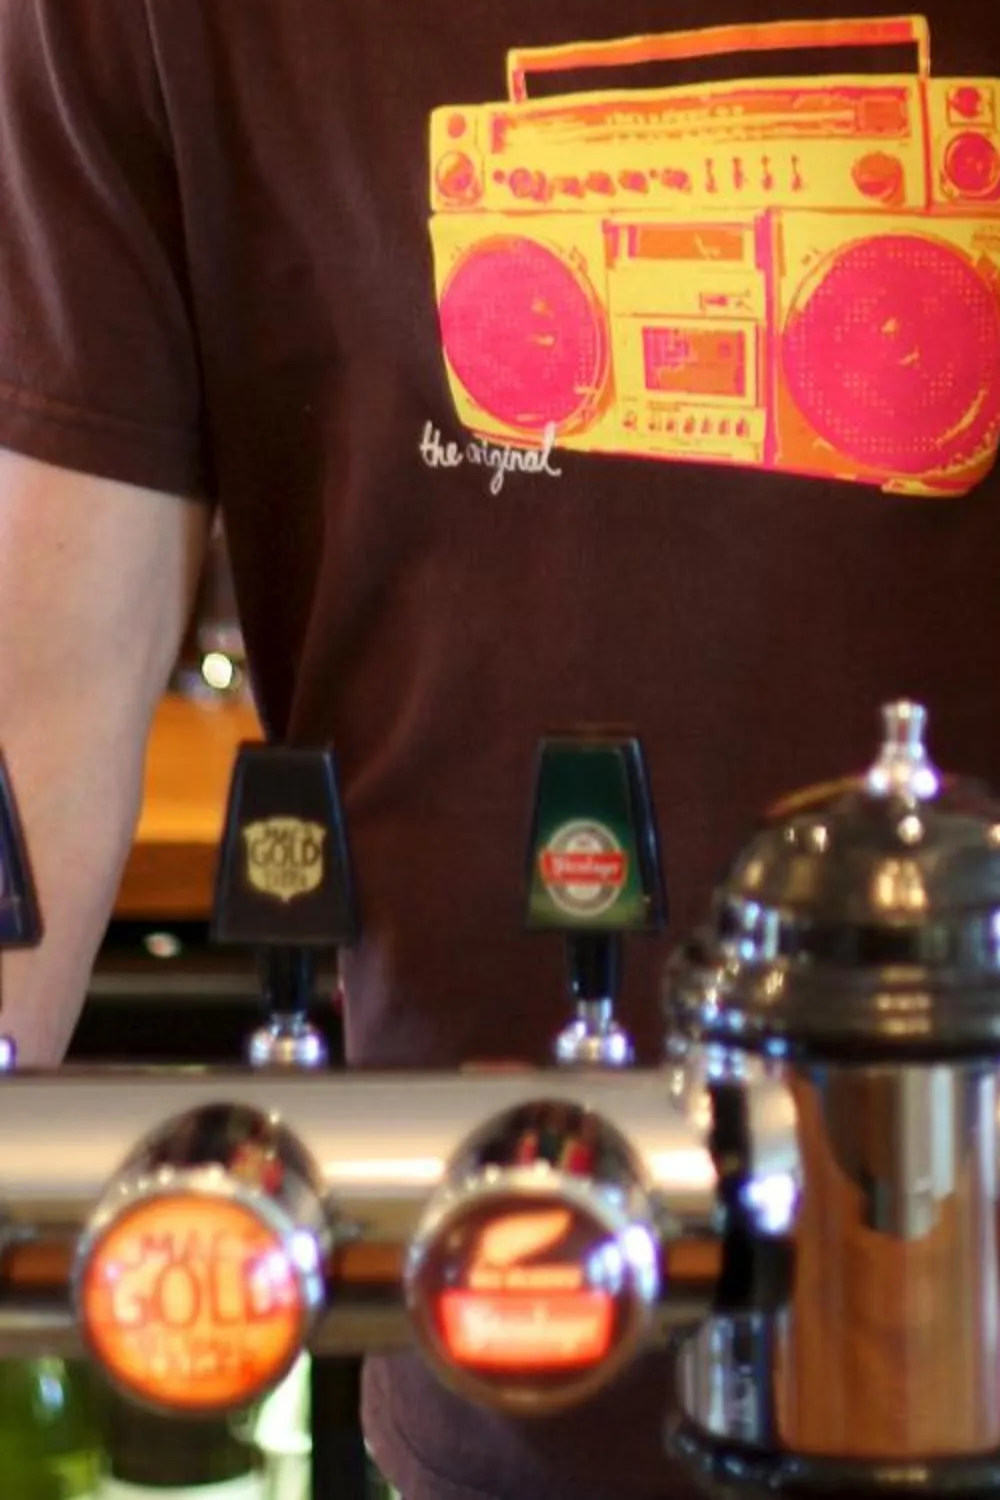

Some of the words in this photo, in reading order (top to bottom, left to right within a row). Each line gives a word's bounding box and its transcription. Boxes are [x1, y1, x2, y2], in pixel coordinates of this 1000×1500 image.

[419, 420, 463, 468] the
[250, 837, 321, 869] GOLD
[108, 1258, 294, 1331] GOLD
